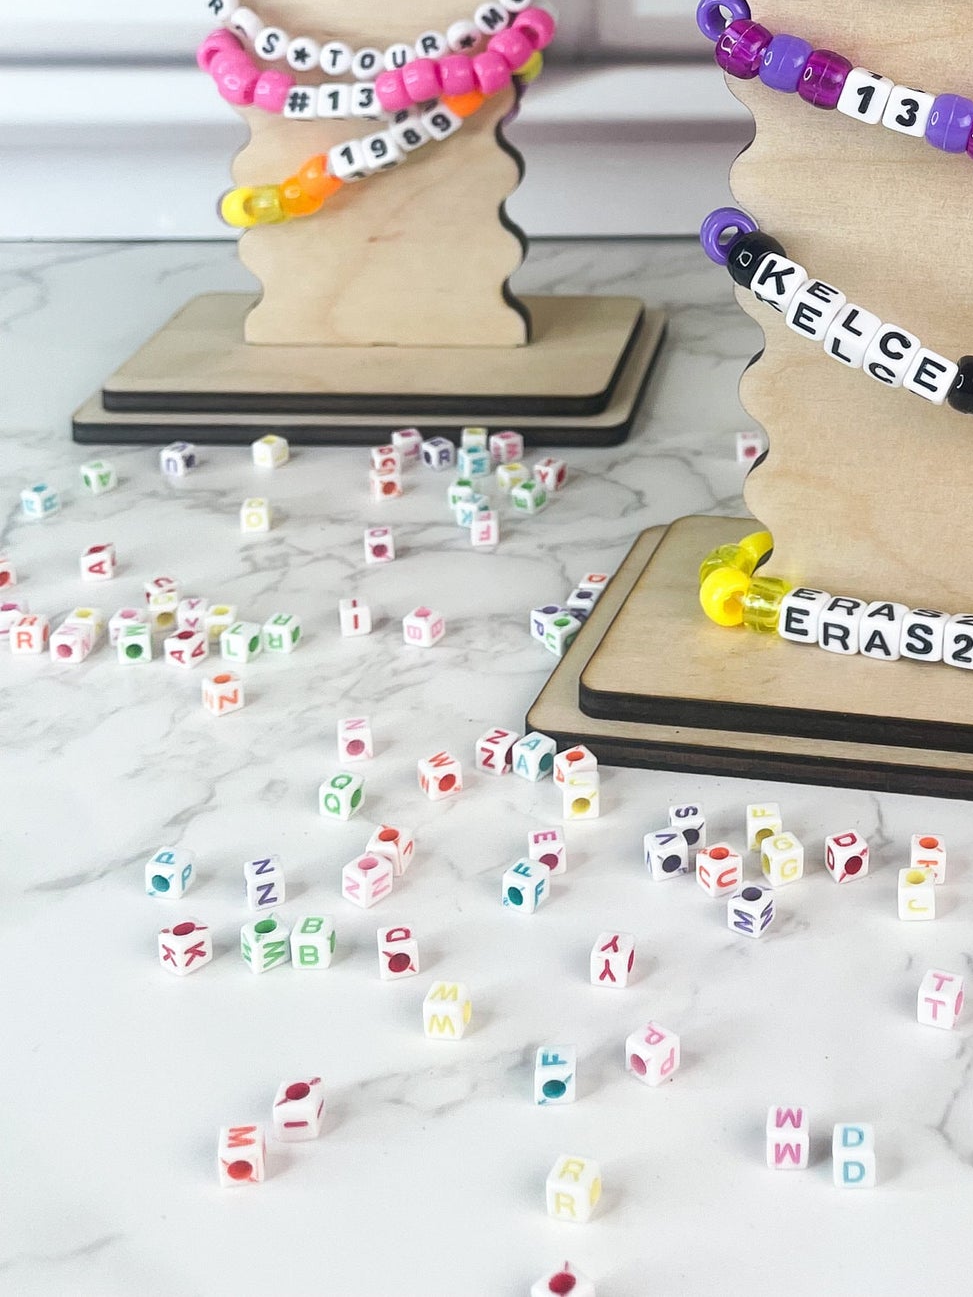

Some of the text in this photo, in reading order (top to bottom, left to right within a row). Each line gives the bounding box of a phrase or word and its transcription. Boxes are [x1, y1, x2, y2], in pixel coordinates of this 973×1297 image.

[329, 36, 441, 69] TOUR
[288, 86, 374, 112] #13
[855, 84, 921, 128] 13
[340, 112, 452, 167] 1989
[757, 259, 947, 394] KELCE
[779, 857, 799, 880] G
[299, 945, 320, 966] B
[932, 972, 954, 992] T
[923, 996, 946, 1021] T
[842, 1127, 865, 1148] D
[562, 1158, 586, 1183] R
[843, 1160, 866, 1184] D
[554, 1191, 577, 1218] R
